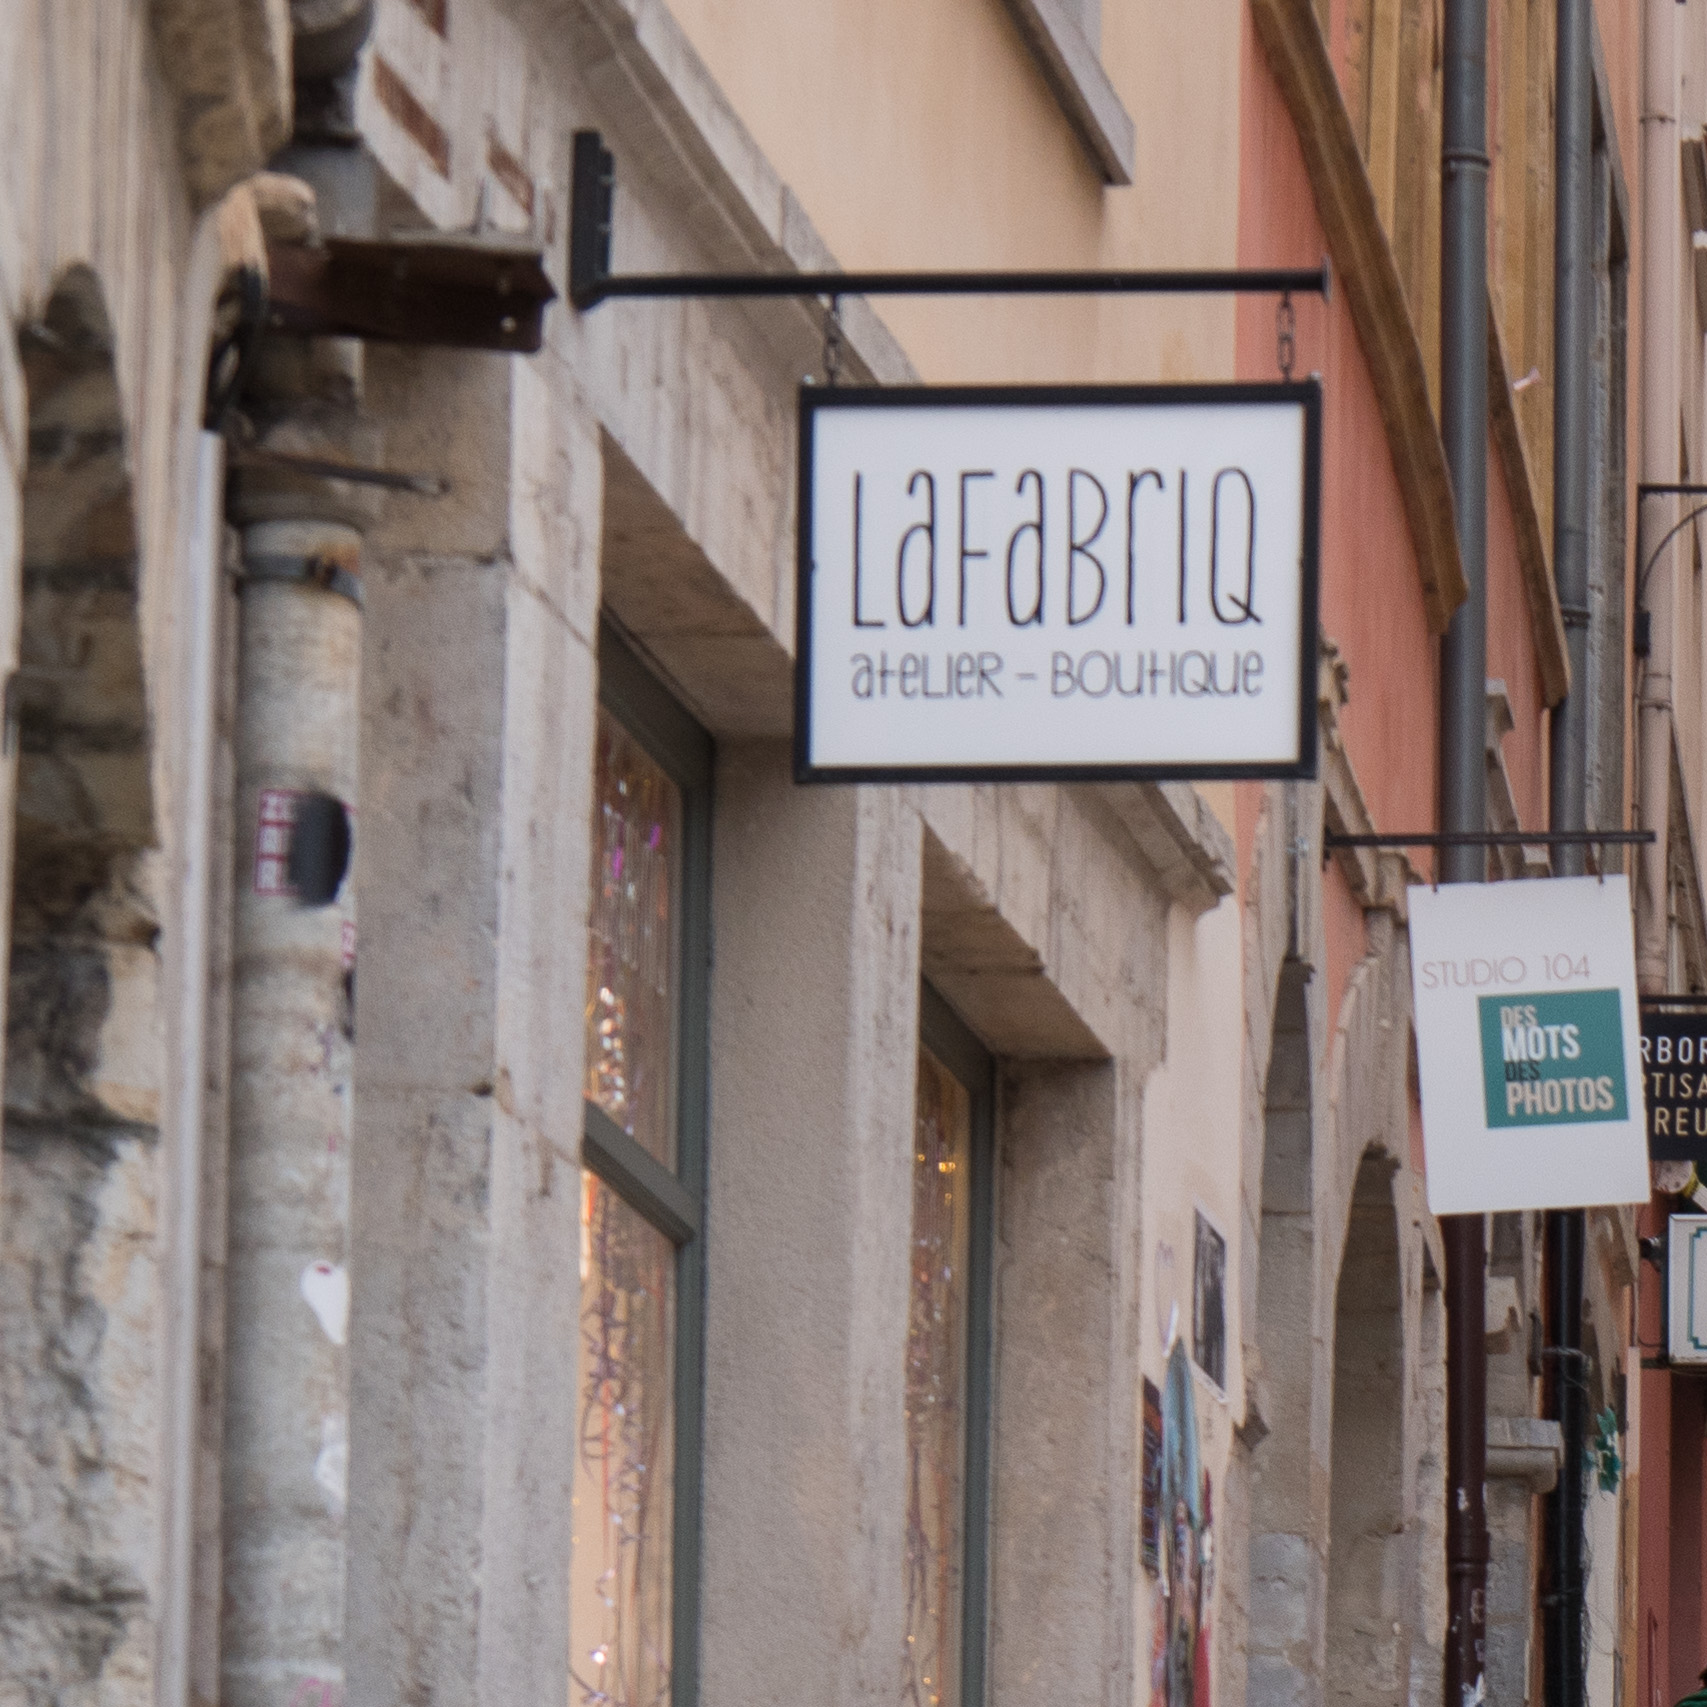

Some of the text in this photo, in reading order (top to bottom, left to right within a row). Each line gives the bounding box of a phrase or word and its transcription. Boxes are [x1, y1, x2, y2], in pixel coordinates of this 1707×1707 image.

[1422, 953, 1591, 990] STUDIO 104
[1500, 1004, 1538, 1028] DES
[1502, 1023, 1581, 1062] MOTS
[1504, 1059, 1541, 1083] DES
[1506, 1076, 1615, 1117] PHOTOS
